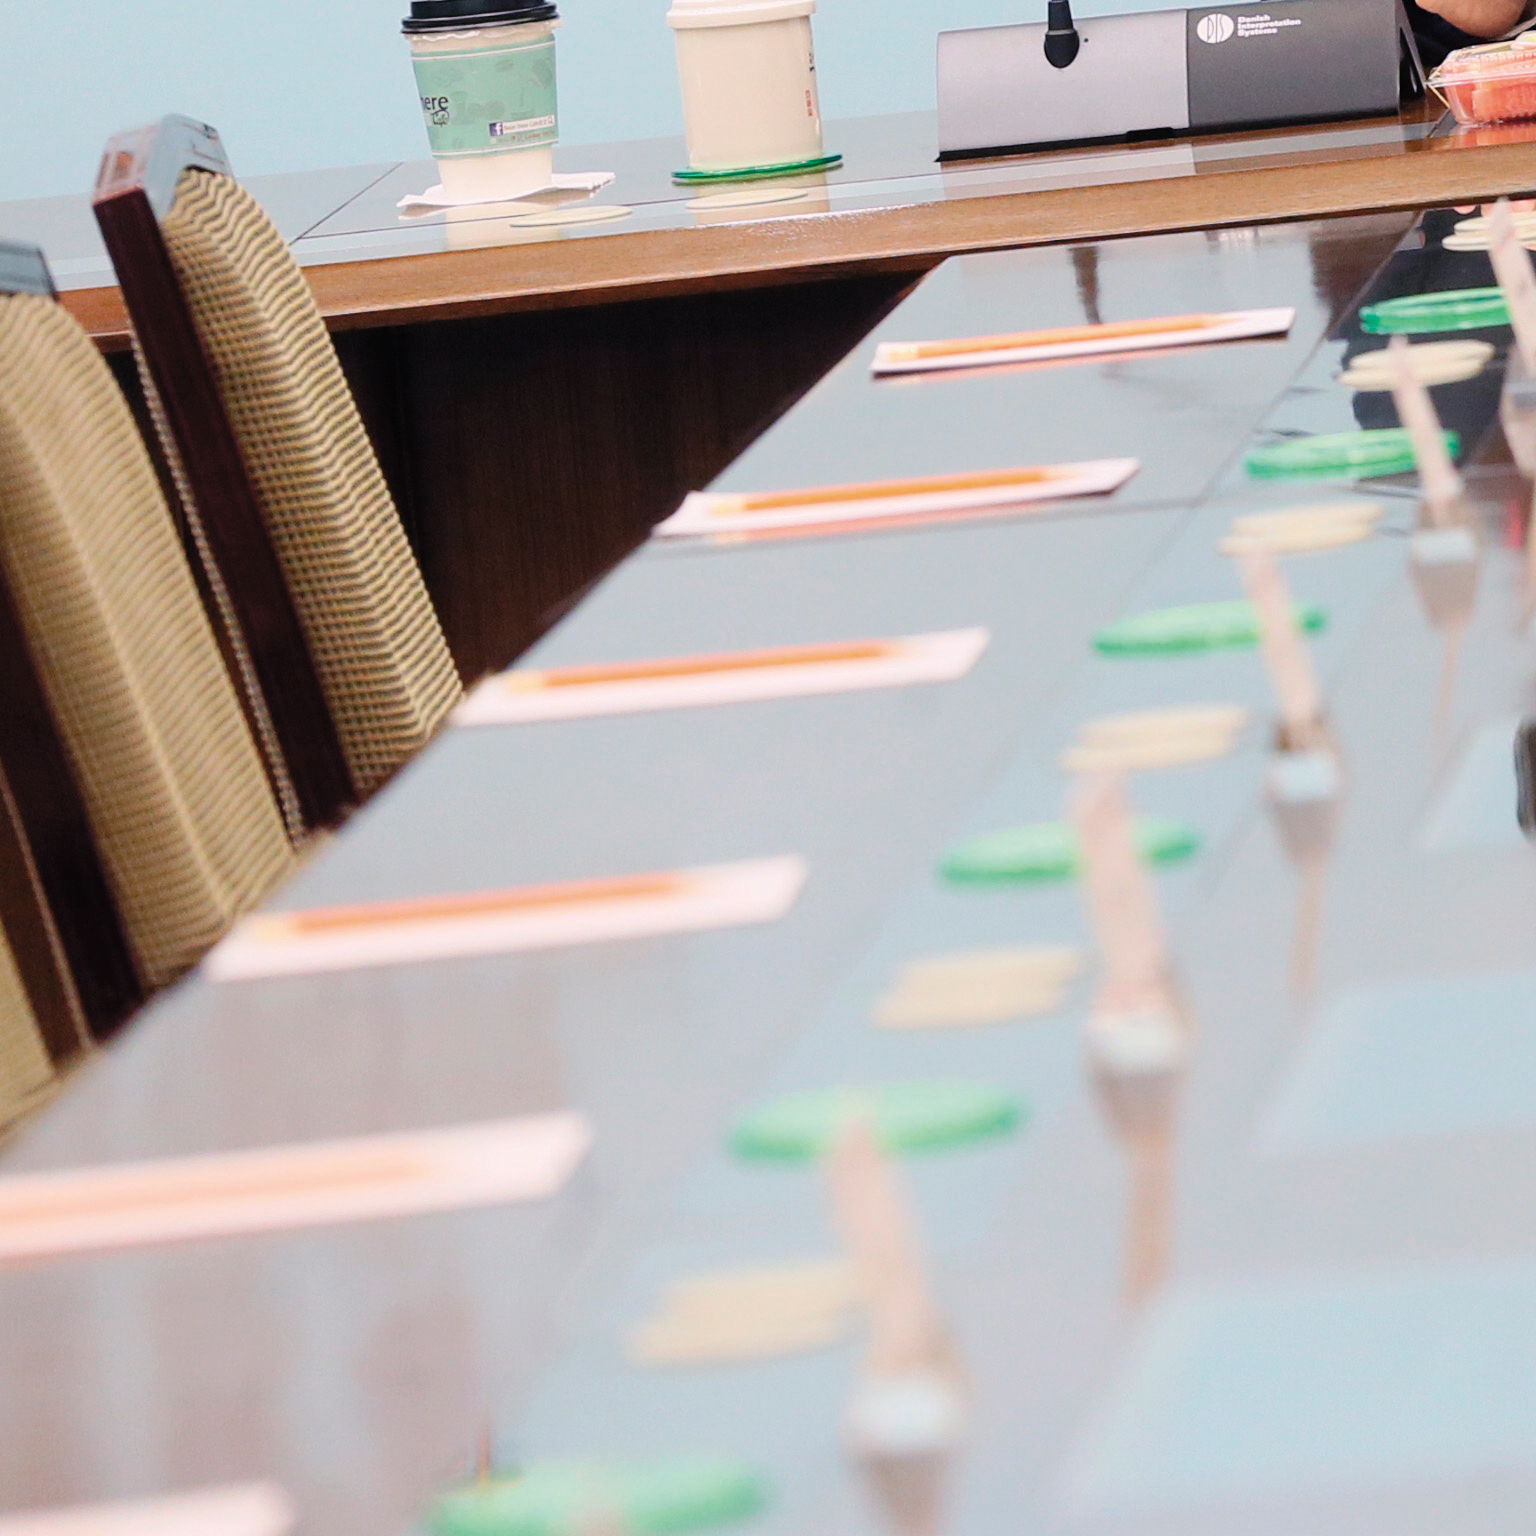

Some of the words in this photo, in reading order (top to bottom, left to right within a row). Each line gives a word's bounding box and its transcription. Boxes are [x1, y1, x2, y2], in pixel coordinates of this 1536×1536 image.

[1238, 14, 1271, 22] Danish
[1238, 19, 1301, 29] Interpretation
[1238, 28, 1278, 37] Systems
